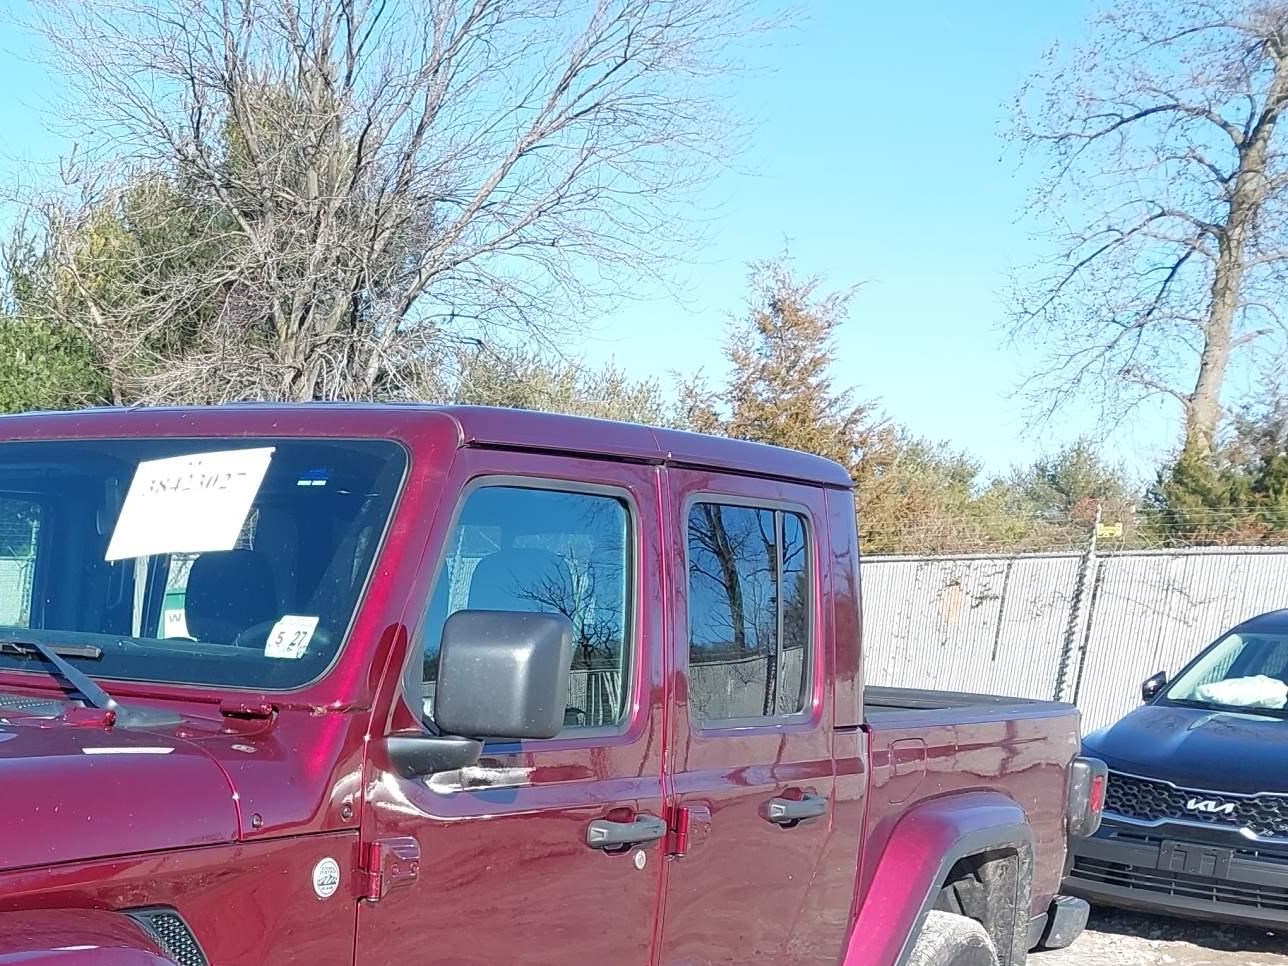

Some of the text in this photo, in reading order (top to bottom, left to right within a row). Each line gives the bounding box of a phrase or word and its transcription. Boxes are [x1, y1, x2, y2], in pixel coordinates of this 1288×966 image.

[141, 472, 249, 497] 384302
[289, 630, 308, 647] 27
[1186, 798, 1235, 814] KIA
